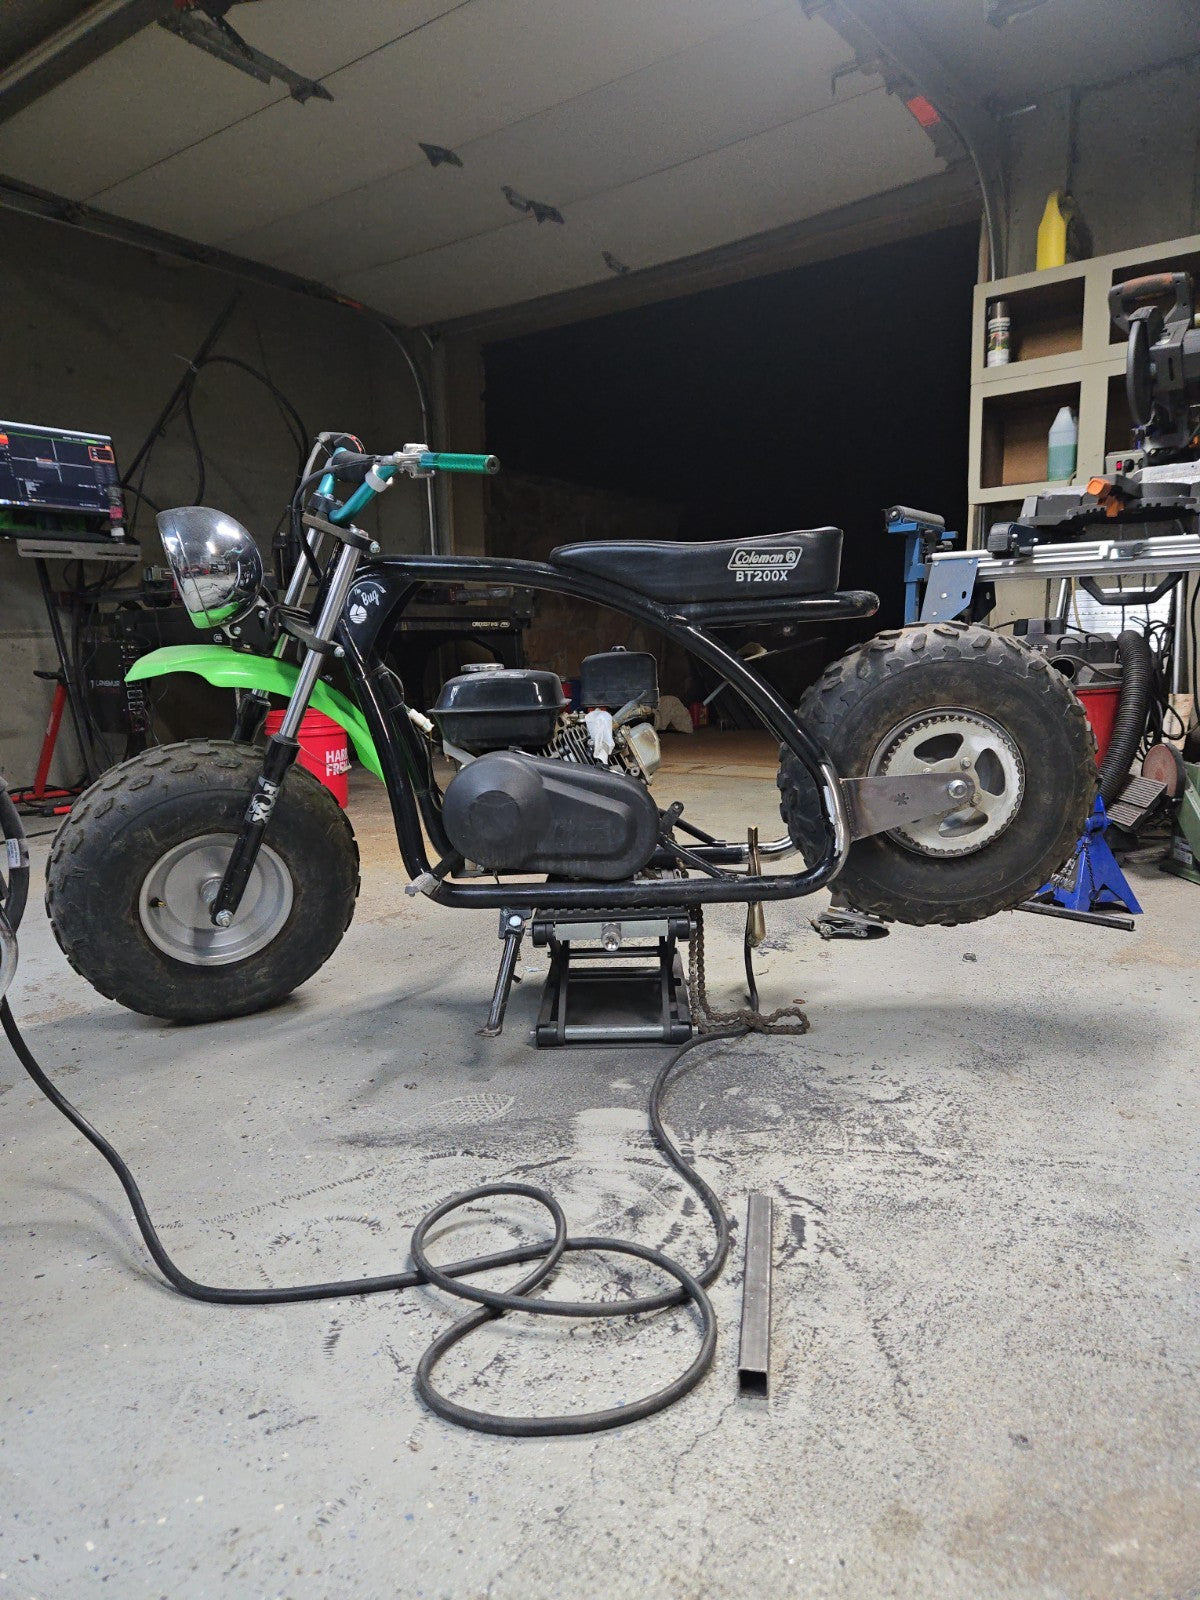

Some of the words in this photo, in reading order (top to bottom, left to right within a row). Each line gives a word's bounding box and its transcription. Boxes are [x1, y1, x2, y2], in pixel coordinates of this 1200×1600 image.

[735, 550, 784, 565] Coleman
[735, 570, 788, 582] BT200X
[360, 589, 380, 606] Bug
[247, 780, 281, 824] FOX
